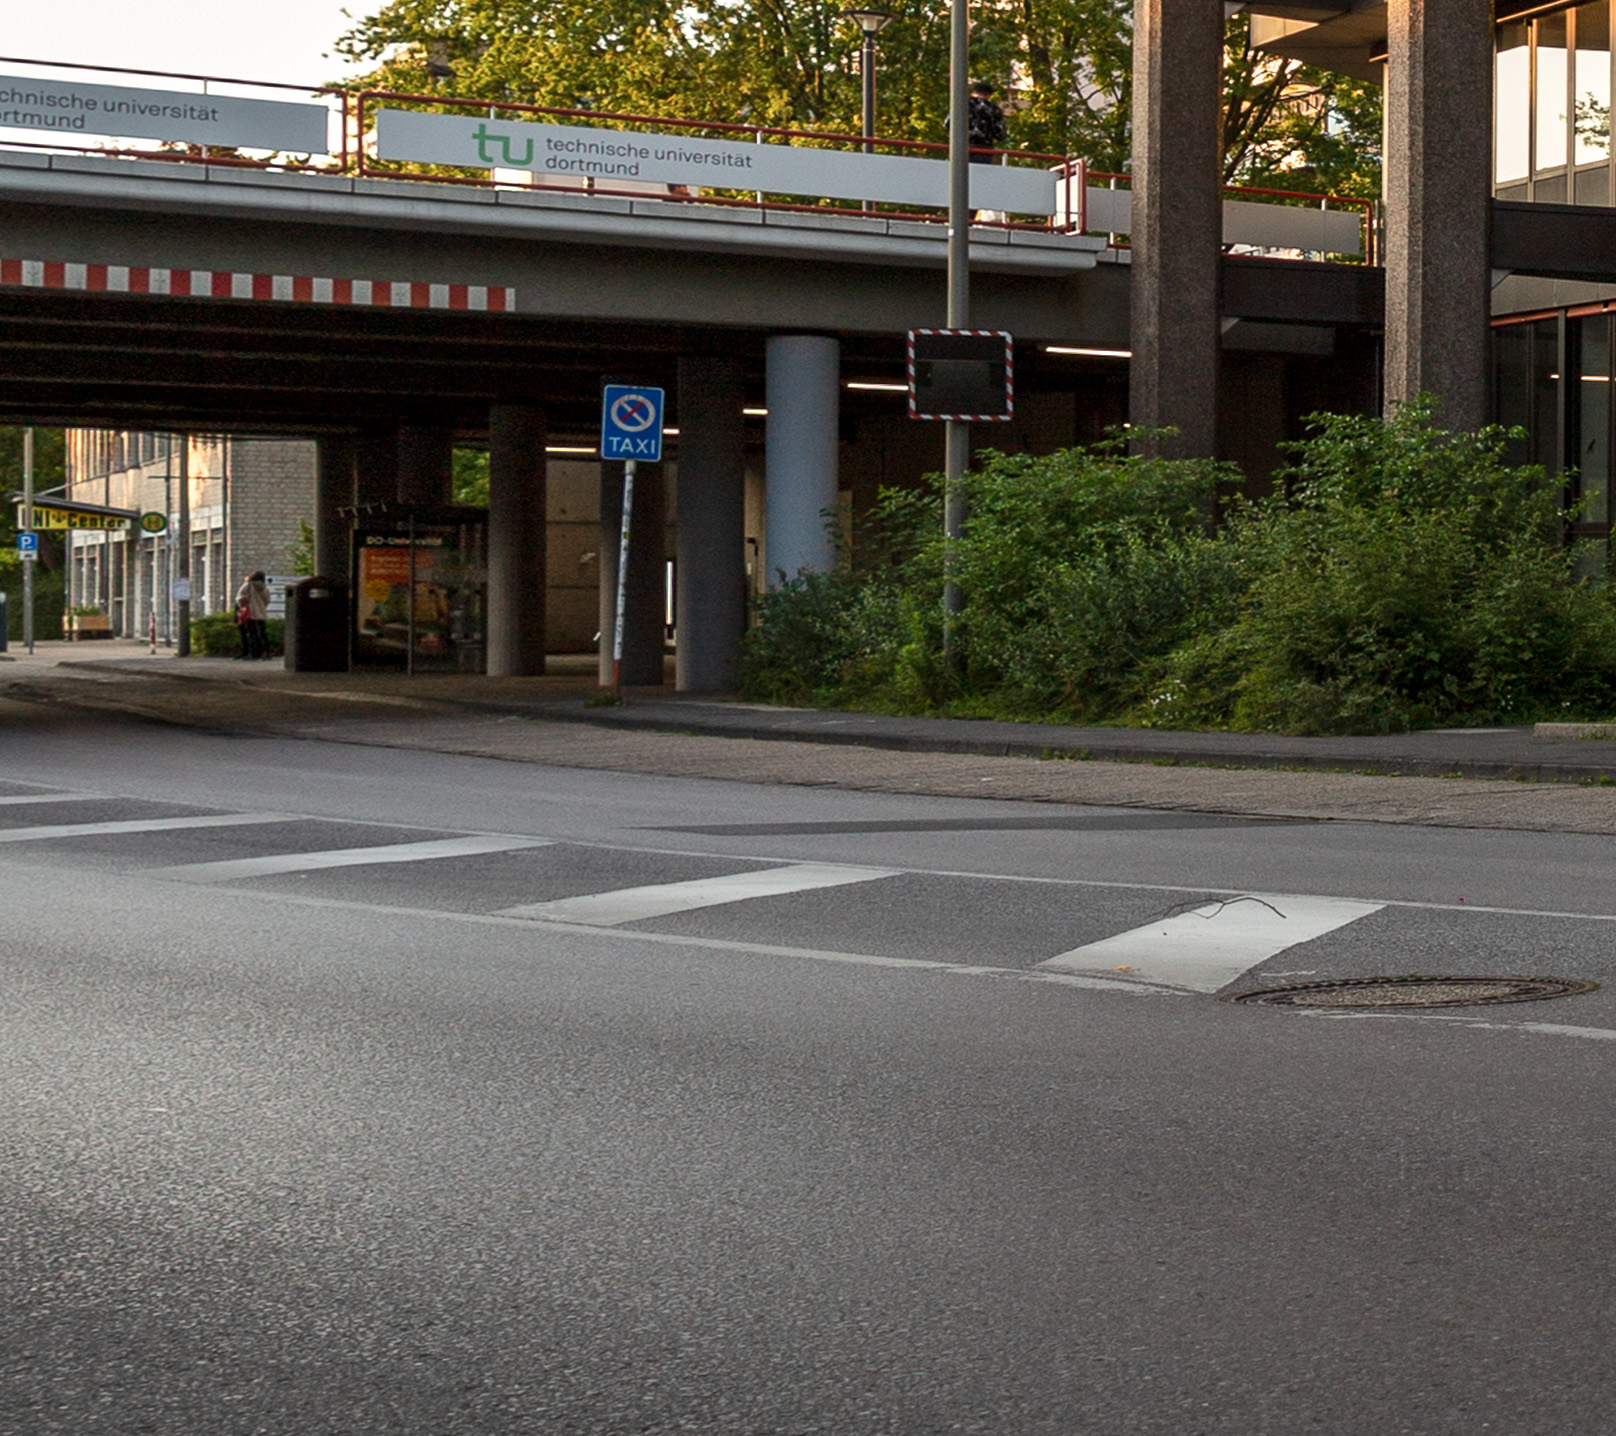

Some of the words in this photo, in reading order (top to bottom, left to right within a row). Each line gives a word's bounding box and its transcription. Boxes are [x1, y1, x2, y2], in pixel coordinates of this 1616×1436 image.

[0, 110, 86, 130] rtmund
[103, 99, 219, 123] universität
[472, 123, 534, 166] tu
[546, 136, 650, 160] technische
[654, 147, 753, 169] universität
[545, 156, 640, 177] dortmund
[608, 436, 656, 455] TAXI
[68, 512, 127, 528] Center
